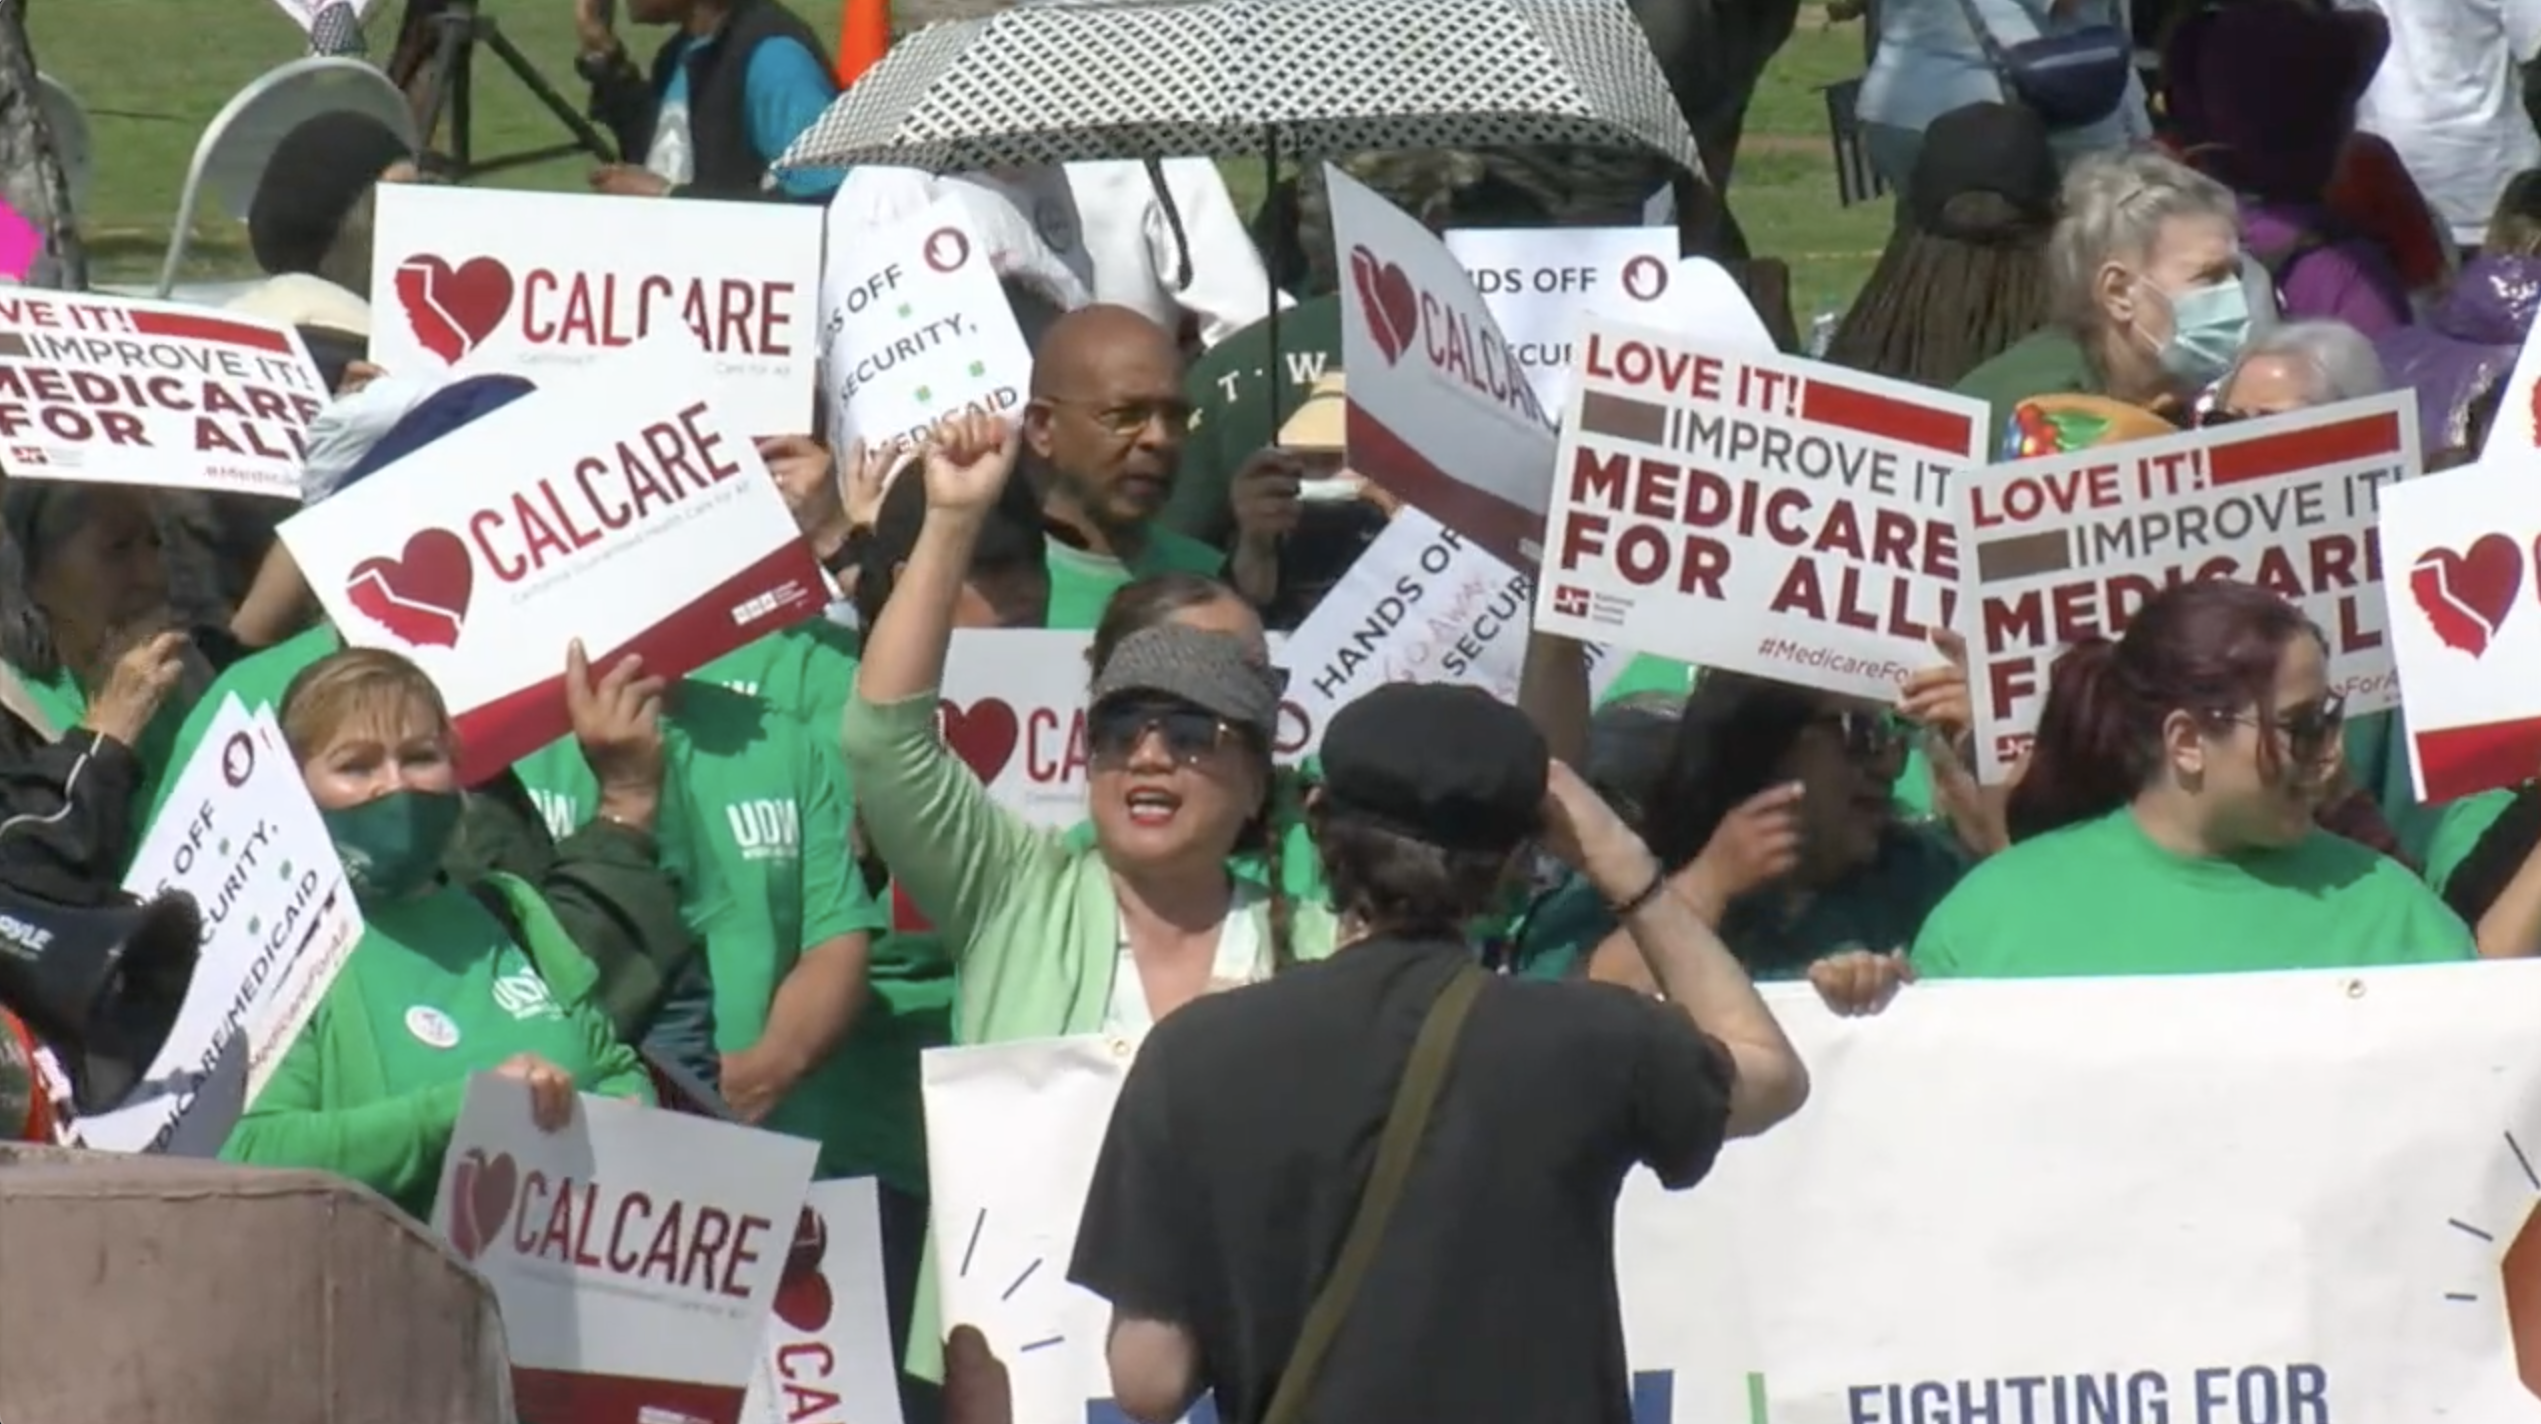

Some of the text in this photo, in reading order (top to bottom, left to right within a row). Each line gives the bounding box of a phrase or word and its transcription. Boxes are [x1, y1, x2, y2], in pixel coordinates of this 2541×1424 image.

[67, 304, 131, 333] IT!
[521, 268, 796, 356] CALCARE
[846, 262, 904, 315] OFF
[1467, 267, 1598, 294] DS OFF
[29, 333, 315, 391] IMPROVE IT!
[1586, 333, 1802, 417] LOVE IT!
[0, 403, 154, 447] FOR
[1670, 406, 1898, 496] IMPROVE
[468, 401, 741, 583] CALCARE
[1570, 446, 1960, 582] MEDICARE
[1970, 448, 2209, 528] LOVE IT!
[2075, 484, 2325, 568] IMPROVE
[1560, 509, 1958, 643] FOR ALL!
[1312, 575, 1426, 700] HANDS
[173, 799, 216, 876] OFF
[726, 798, 800, 848] UDW
[512, 1169, 772, 1299] CALCARE
[1847, 1363, 2330, 1424] FIGHTING FOR
